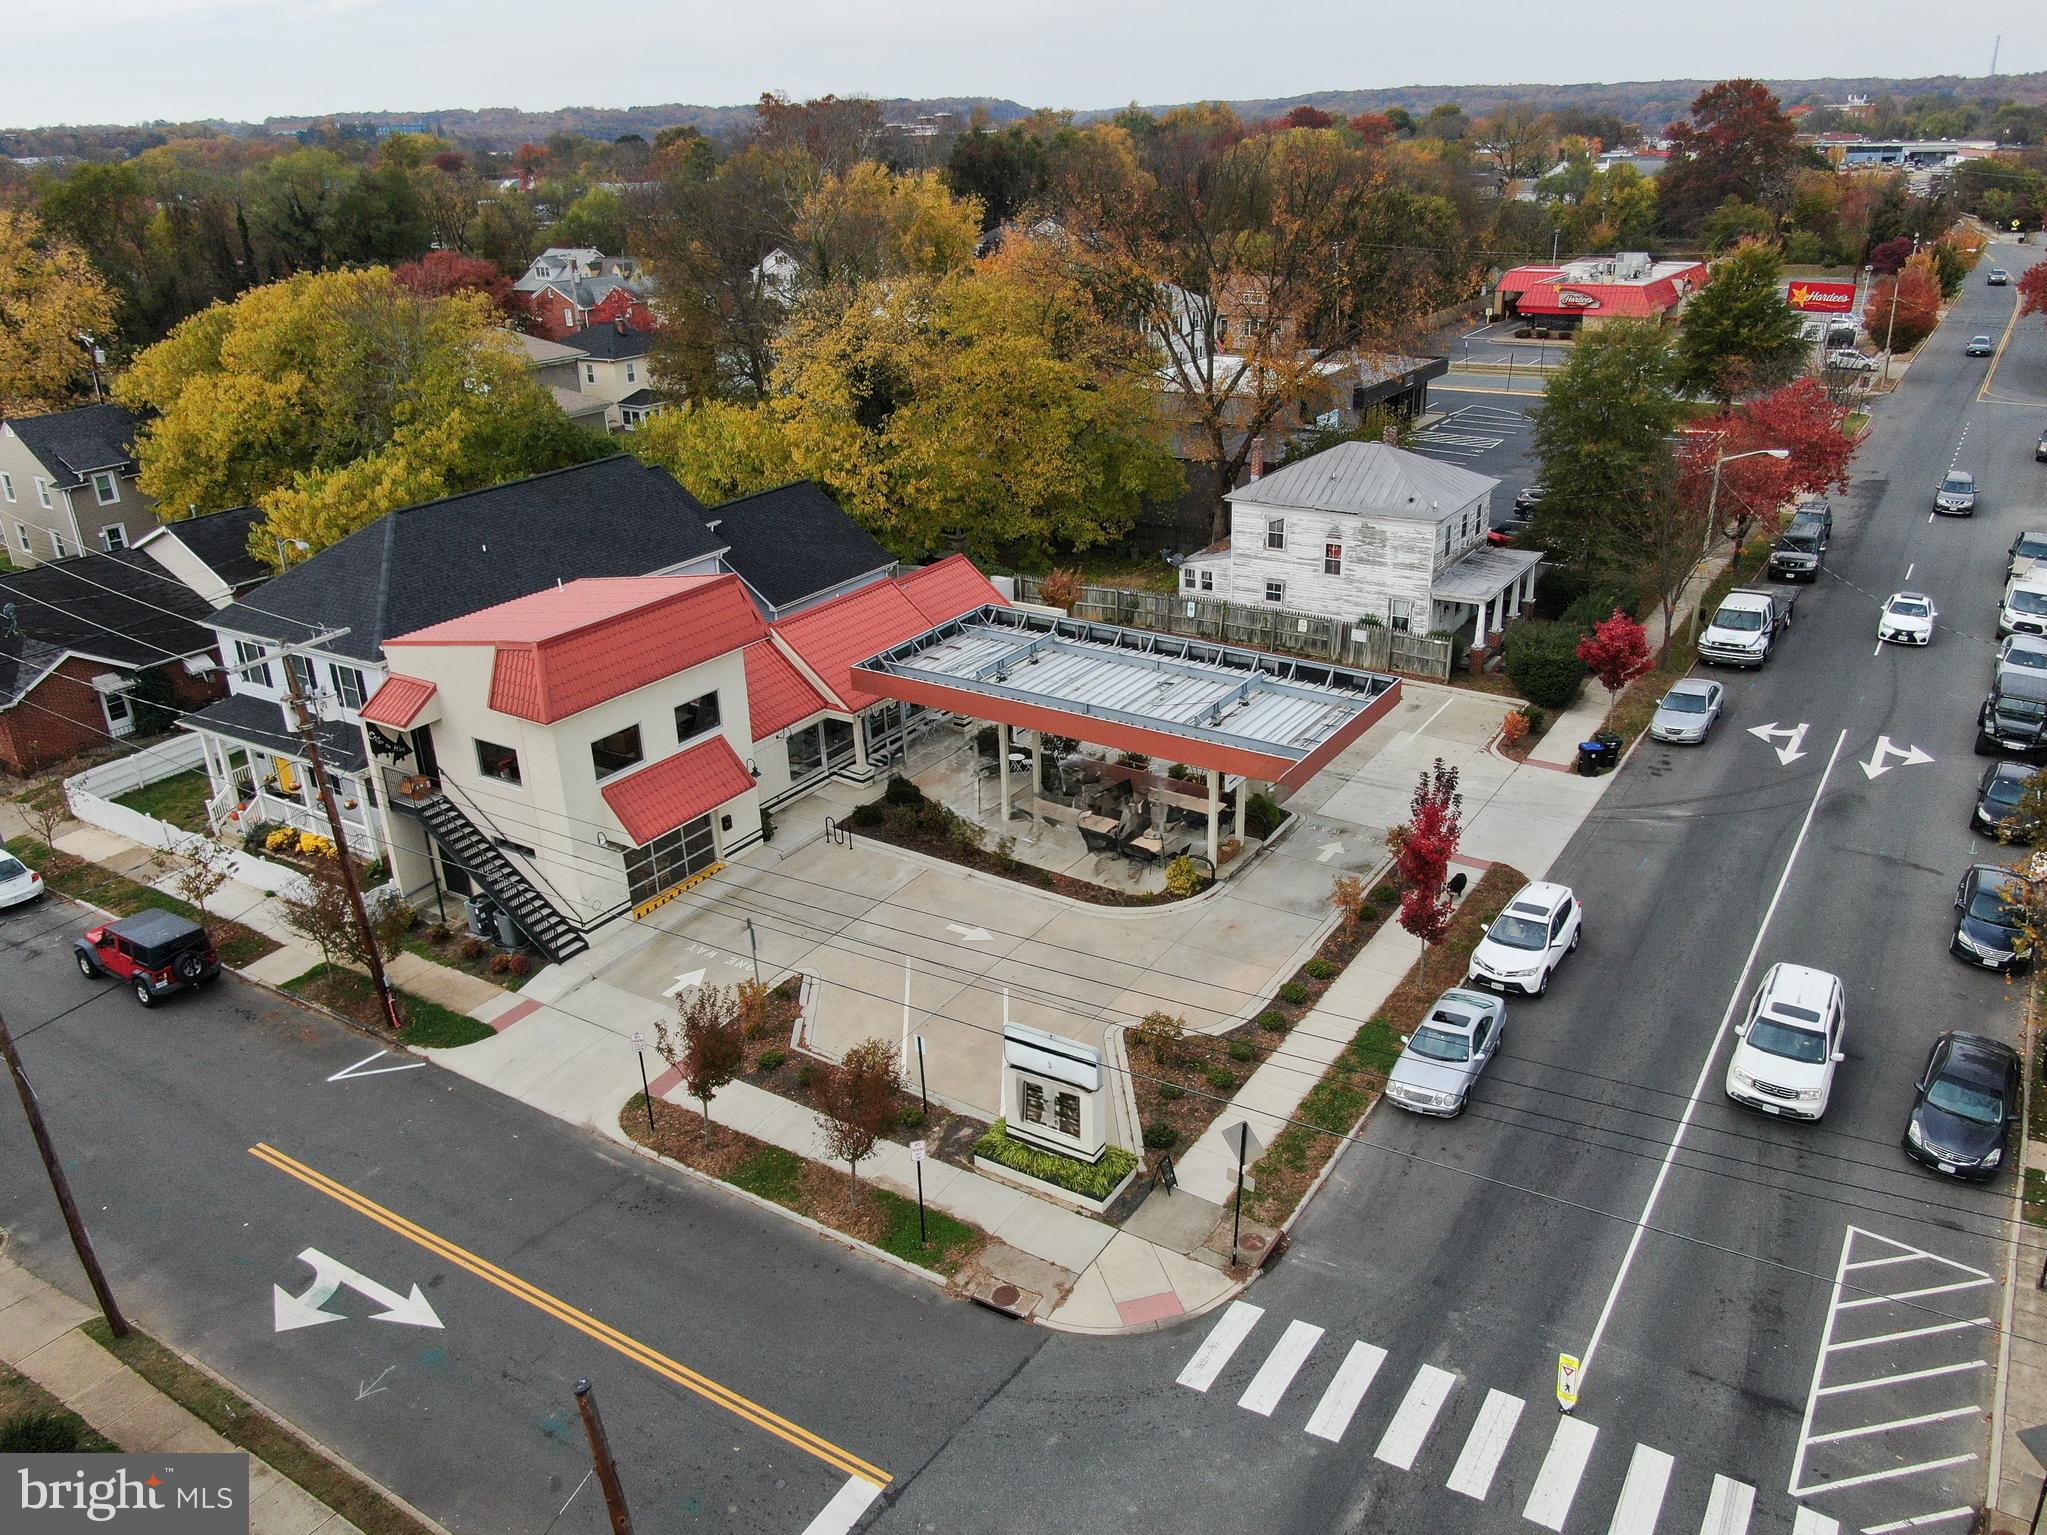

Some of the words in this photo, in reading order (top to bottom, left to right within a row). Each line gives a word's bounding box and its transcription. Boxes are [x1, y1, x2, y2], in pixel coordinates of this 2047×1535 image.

[1804, 291, 1850, 302] Hardee's
[368, 731, 384, 744] Enter
[686, 944, 718, 959] WAY
[724, 957, 756, 971] ONE
